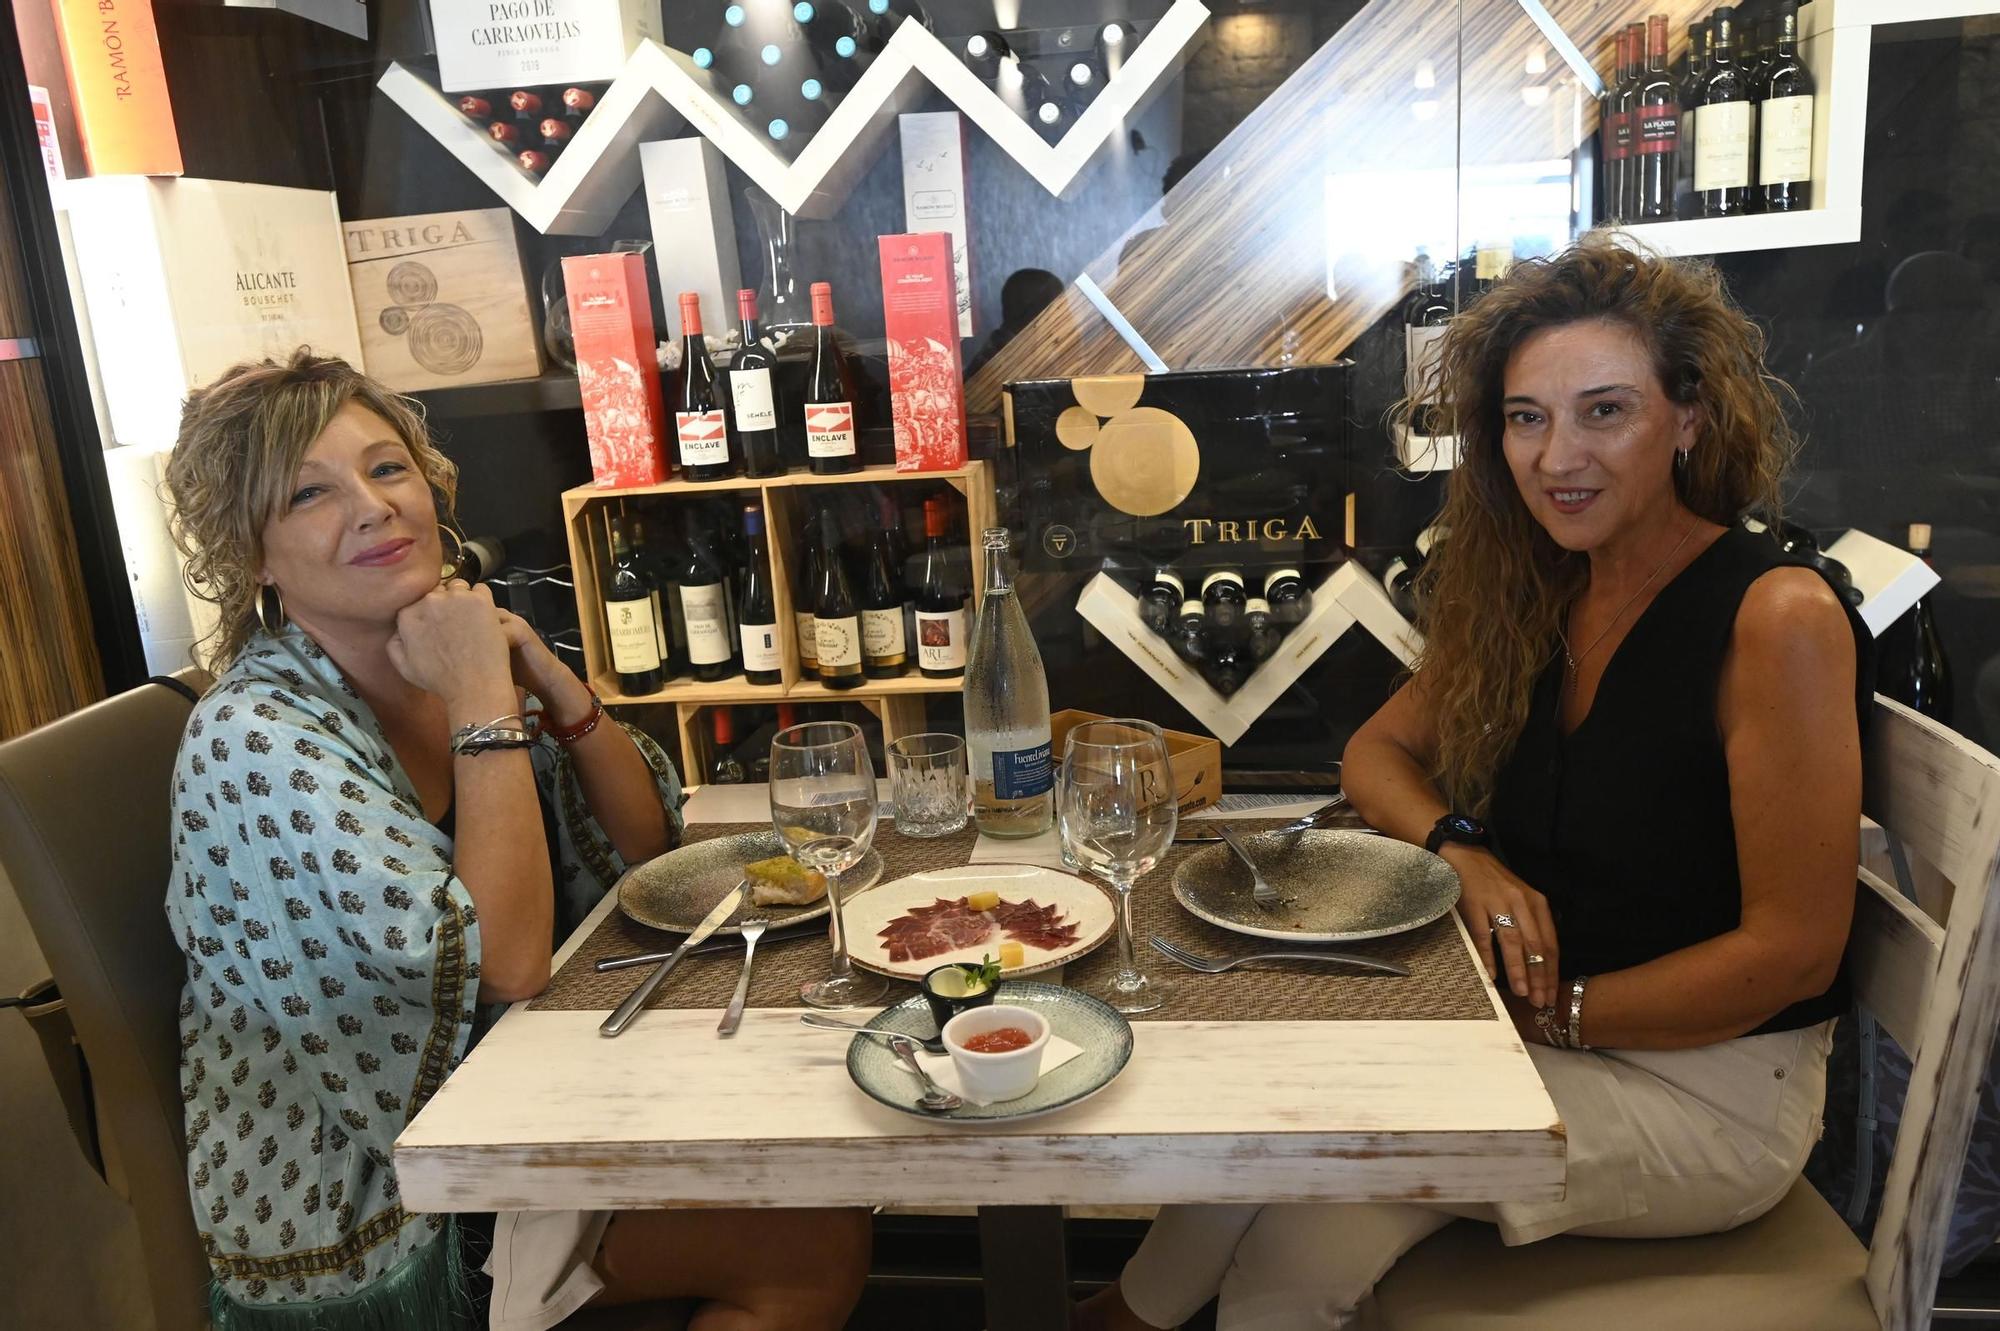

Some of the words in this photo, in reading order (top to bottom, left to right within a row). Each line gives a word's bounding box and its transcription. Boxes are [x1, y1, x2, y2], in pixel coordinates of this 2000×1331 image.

[489, 0, 530, 21] PAGO
[534, 0, 556, 17] DE
[471, 19, 581, 46] CARRAOVEJAS
[348, 220, 476, 252] TRIGA
[236, 271, 297, 291] ALICANTE
[243, 293, 294, 306] BOUSCHET
[684, 441, 720, 450] ENCLAVE
[811, 433, 847, 442] ENCLAVE
[1184, 514, 1323, 545] TRIGA
[922, 647, 942, 661] ART
